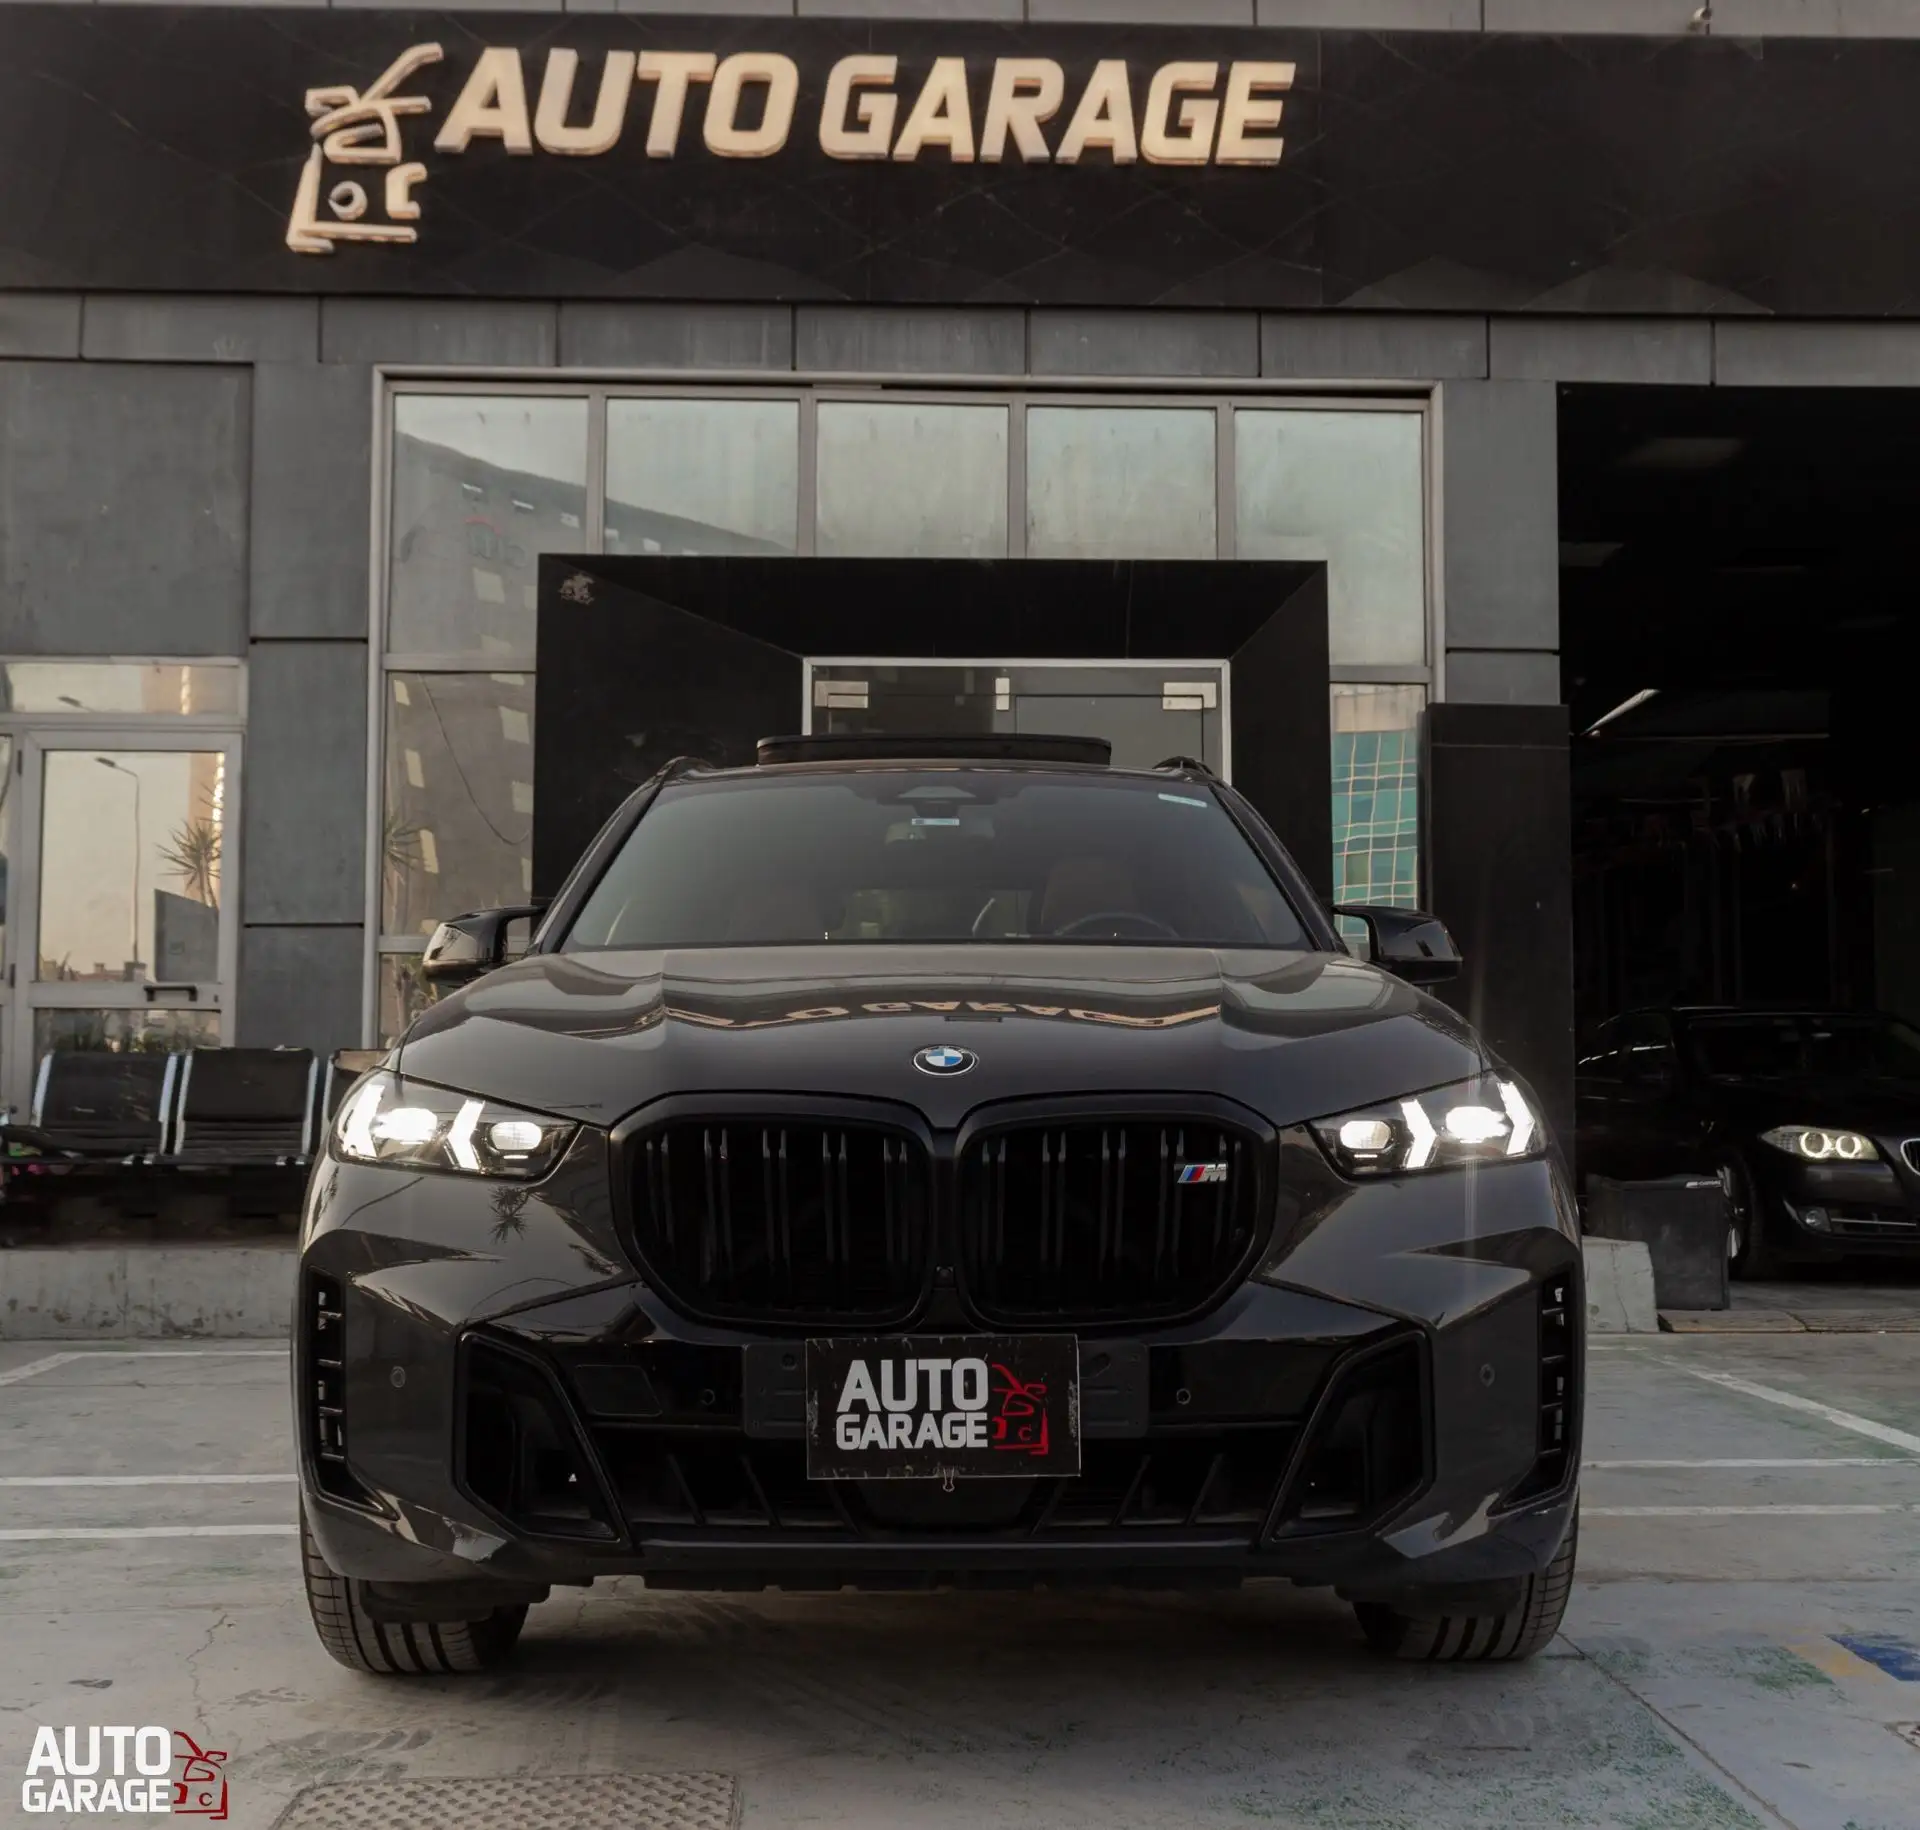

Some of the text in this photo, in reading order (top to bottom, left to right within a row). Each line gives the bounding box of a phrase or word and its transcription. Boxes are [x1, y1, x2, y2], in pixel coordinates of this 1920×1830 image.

[434, 47, 1296, 166] AUTO GARAGE
[837, 1358, 988, 1412] AUTO
[836, 1412, 988, 1450] GARAGE
